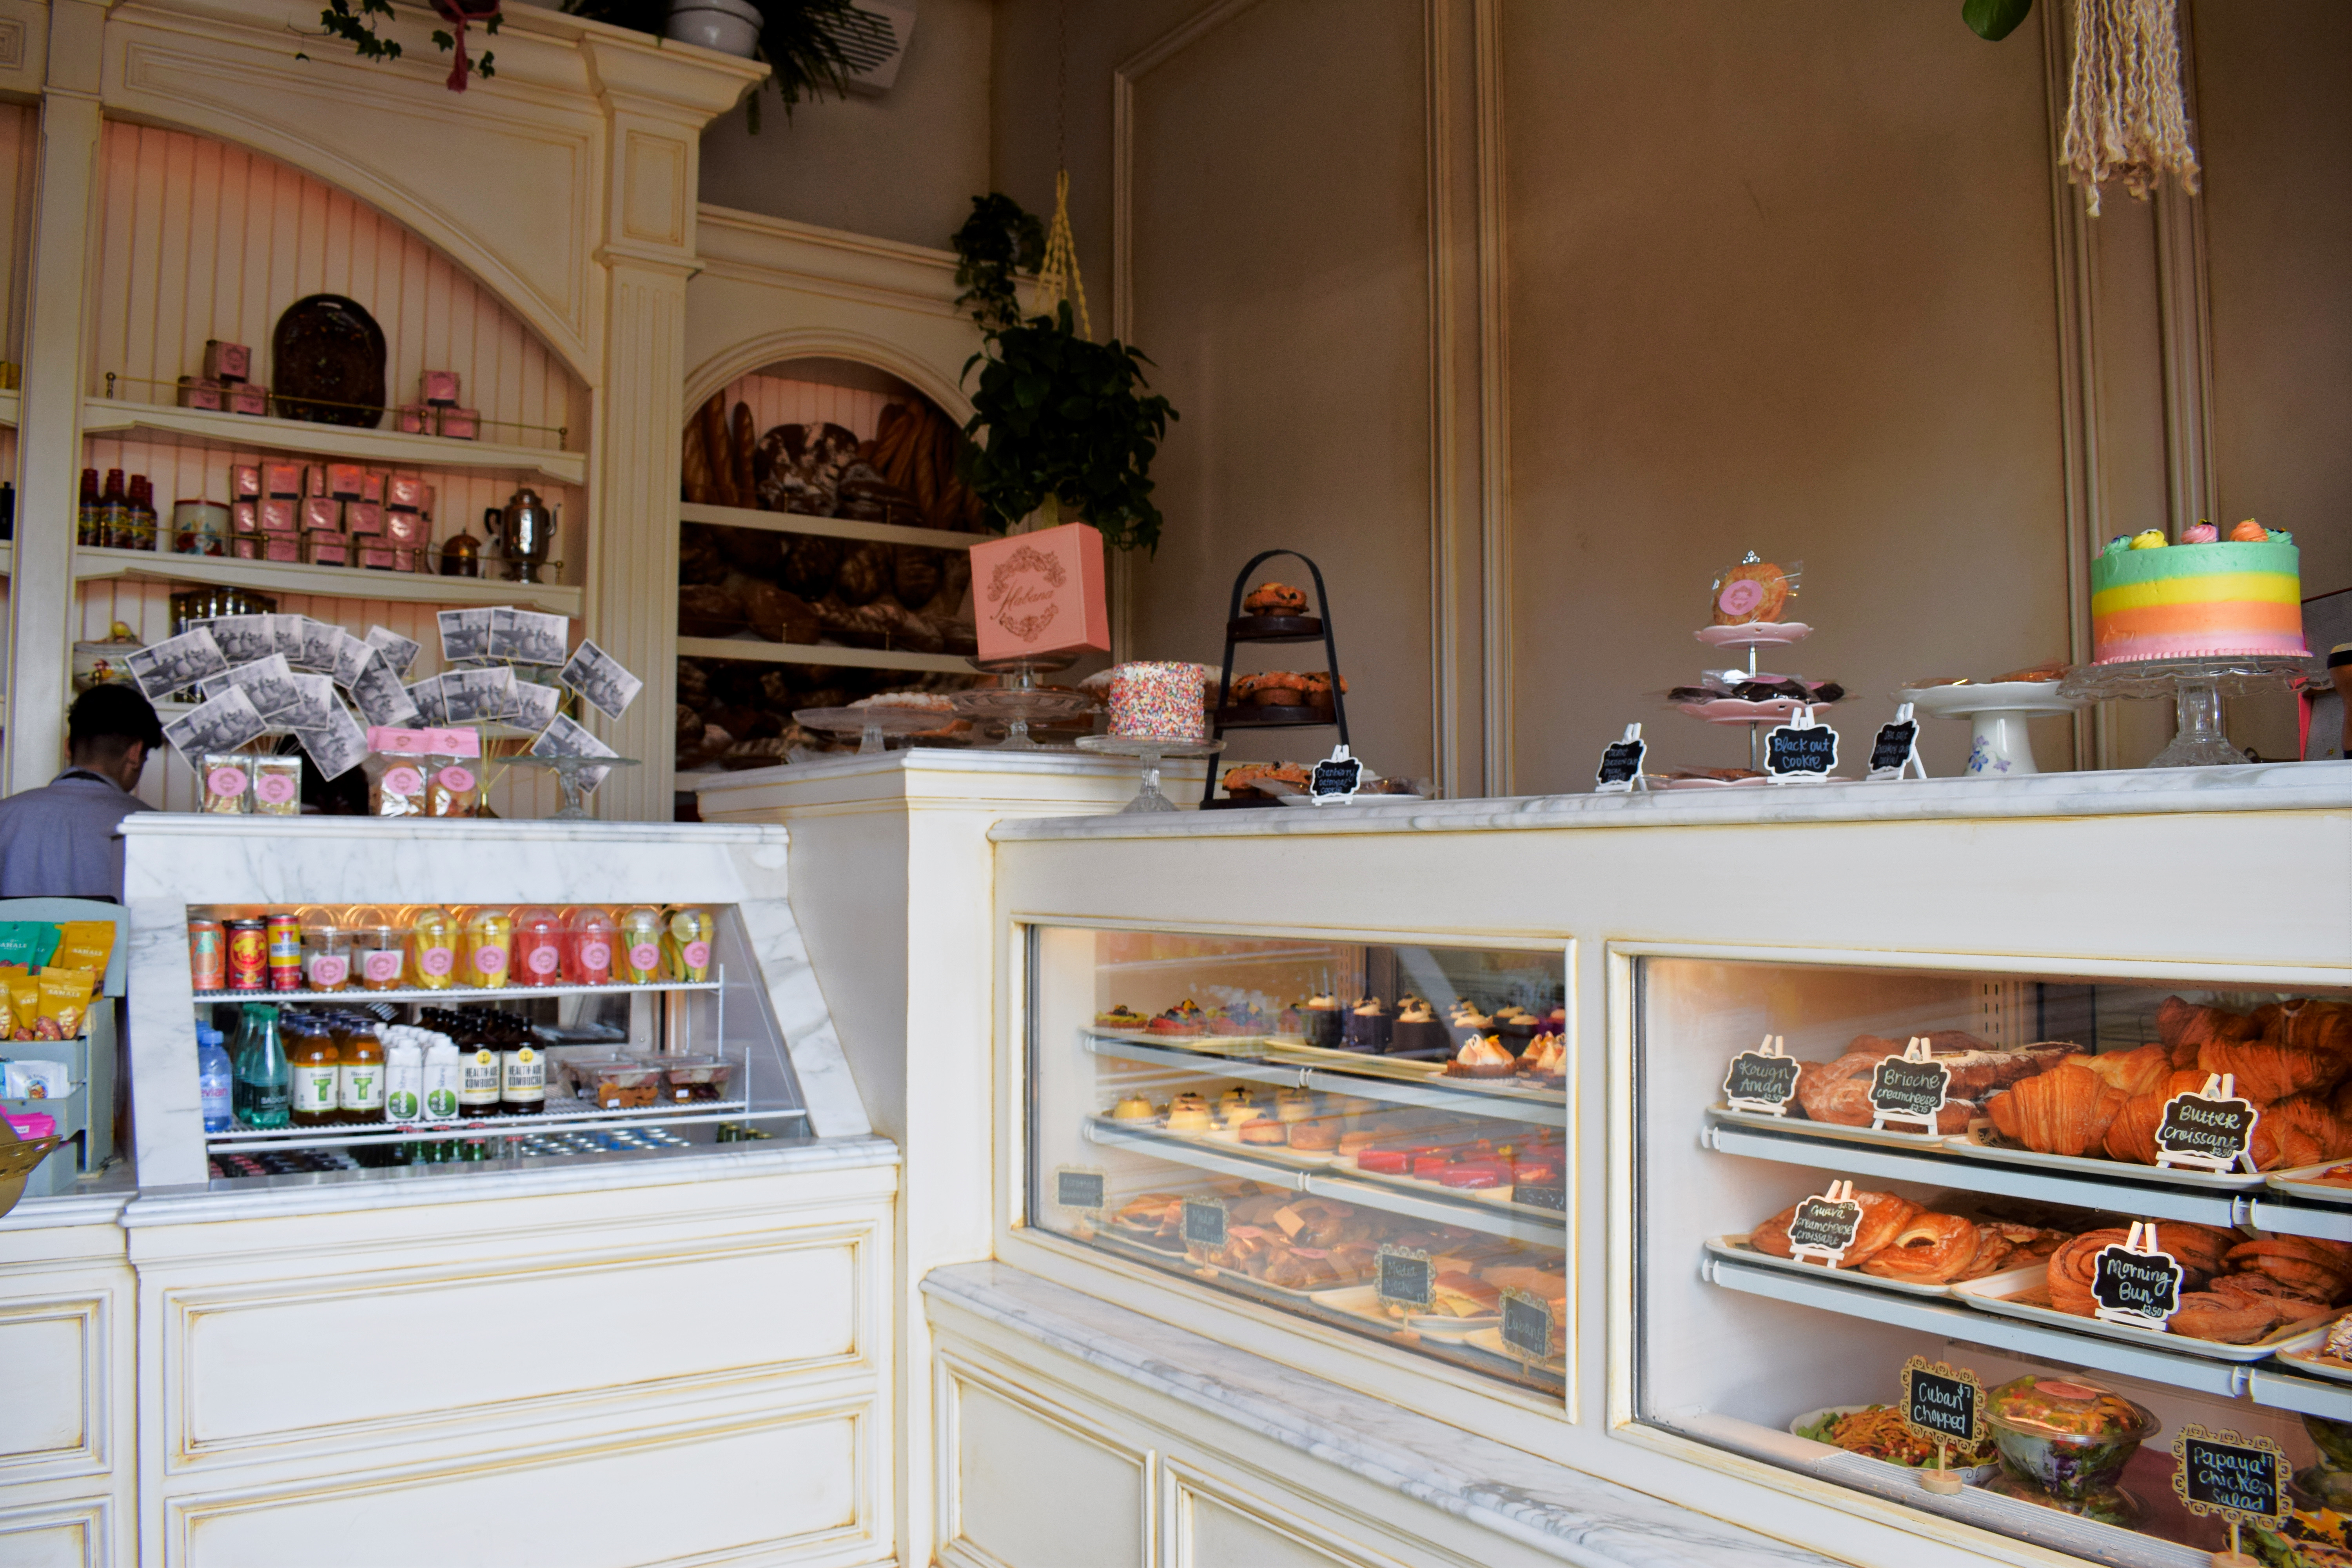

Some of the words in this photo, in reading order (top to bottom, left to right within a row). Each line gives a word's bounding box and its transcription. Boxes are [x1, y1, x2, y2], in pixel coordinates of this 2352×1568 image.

[1774, 736, 1807, 753] Black
[1809, 738, 1830, 752] out
[1740, 1078, 1785, 1094] Aman
[1884, 1069, 1940, 1090] Brioche
[1877, 1089, 1938, 1106] creamcheese
[1909, 1103, 1929, 1113] $2.75
[2209, 1147, 2233, 1157] $2.50
[1810, 1204, 1845, 1219] Guava
[2107, 1259, 2173, 1296] Morning
[2119, 1281, 2153, 1304] Bun
[2141, 1304, 2162, 1316] $2.50
[1919, 1382, 1963, 1411] Cuban
[1957, 1383, 1971, 1398] $7
[1914, 1405, 1965, 1434] Chopped
[2194, 1446, 2265, 1476] Papaya
[2260, 1452, 2273, 1468] $7
